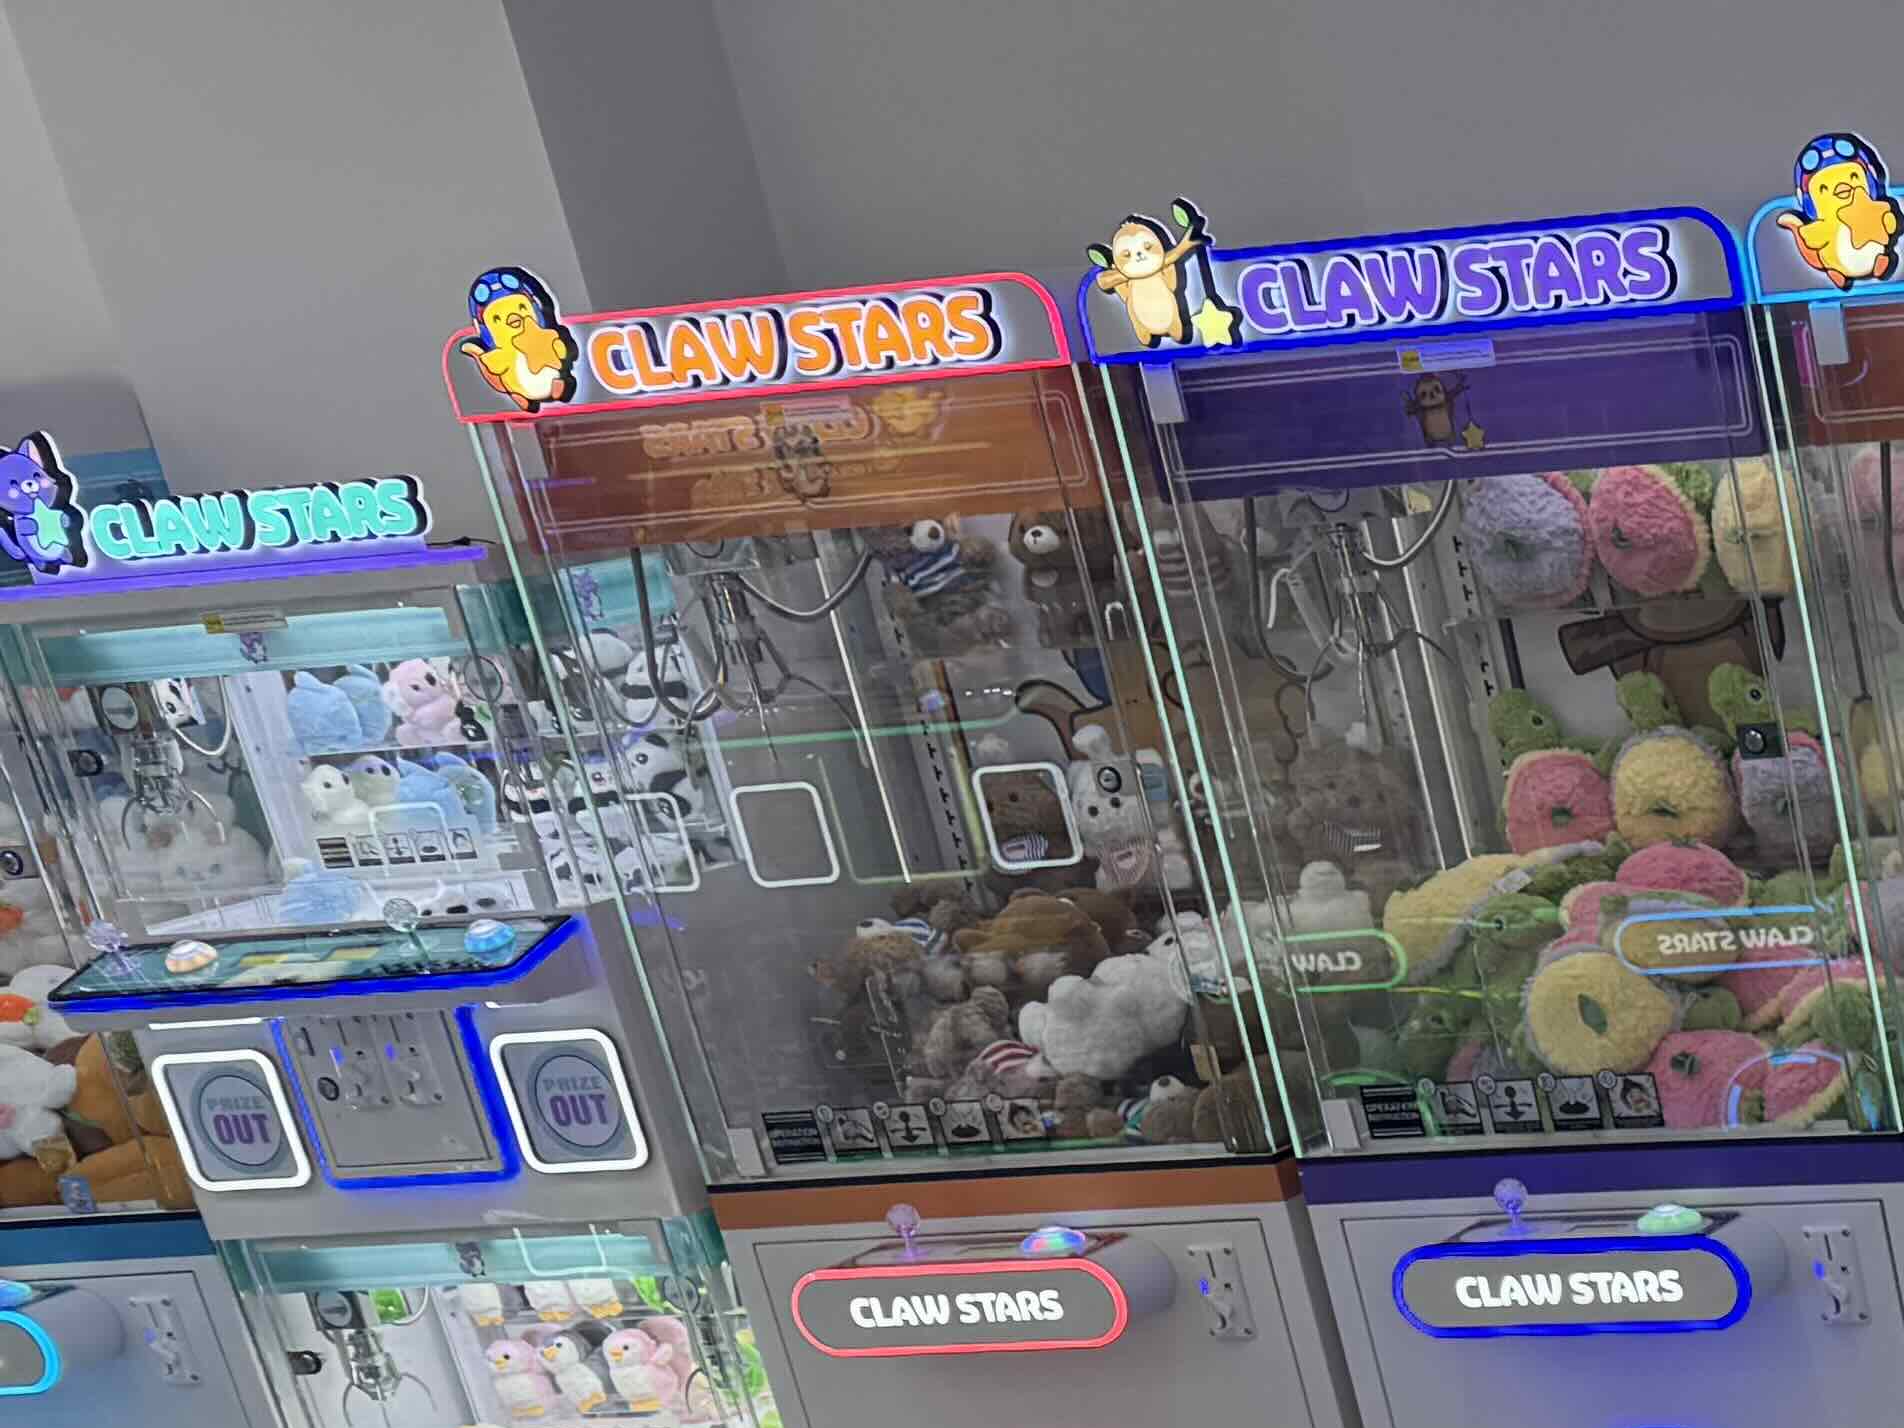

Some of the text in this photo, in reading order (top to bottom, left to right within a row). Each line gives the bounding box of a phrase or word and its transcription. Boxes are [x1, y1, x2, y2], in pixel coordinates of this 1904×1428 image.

[1237, 229, 1672, 333] CLAW STARS
[589, 291, 993, 391] CLAW STARS
[90, 479, 419, 561] CLAW STARS
[205, 1094, 264, 1112] PRIZE
[543, 1074, 604, 1094] PRIZE
[214, 1113, 271, 1145] OUT
[549, 1093, 610, 1128] OUT
[1456, 1270, 1684, 1308] CLAW STARS
[850, 1290, 1063, 1329] CLAW STARS
